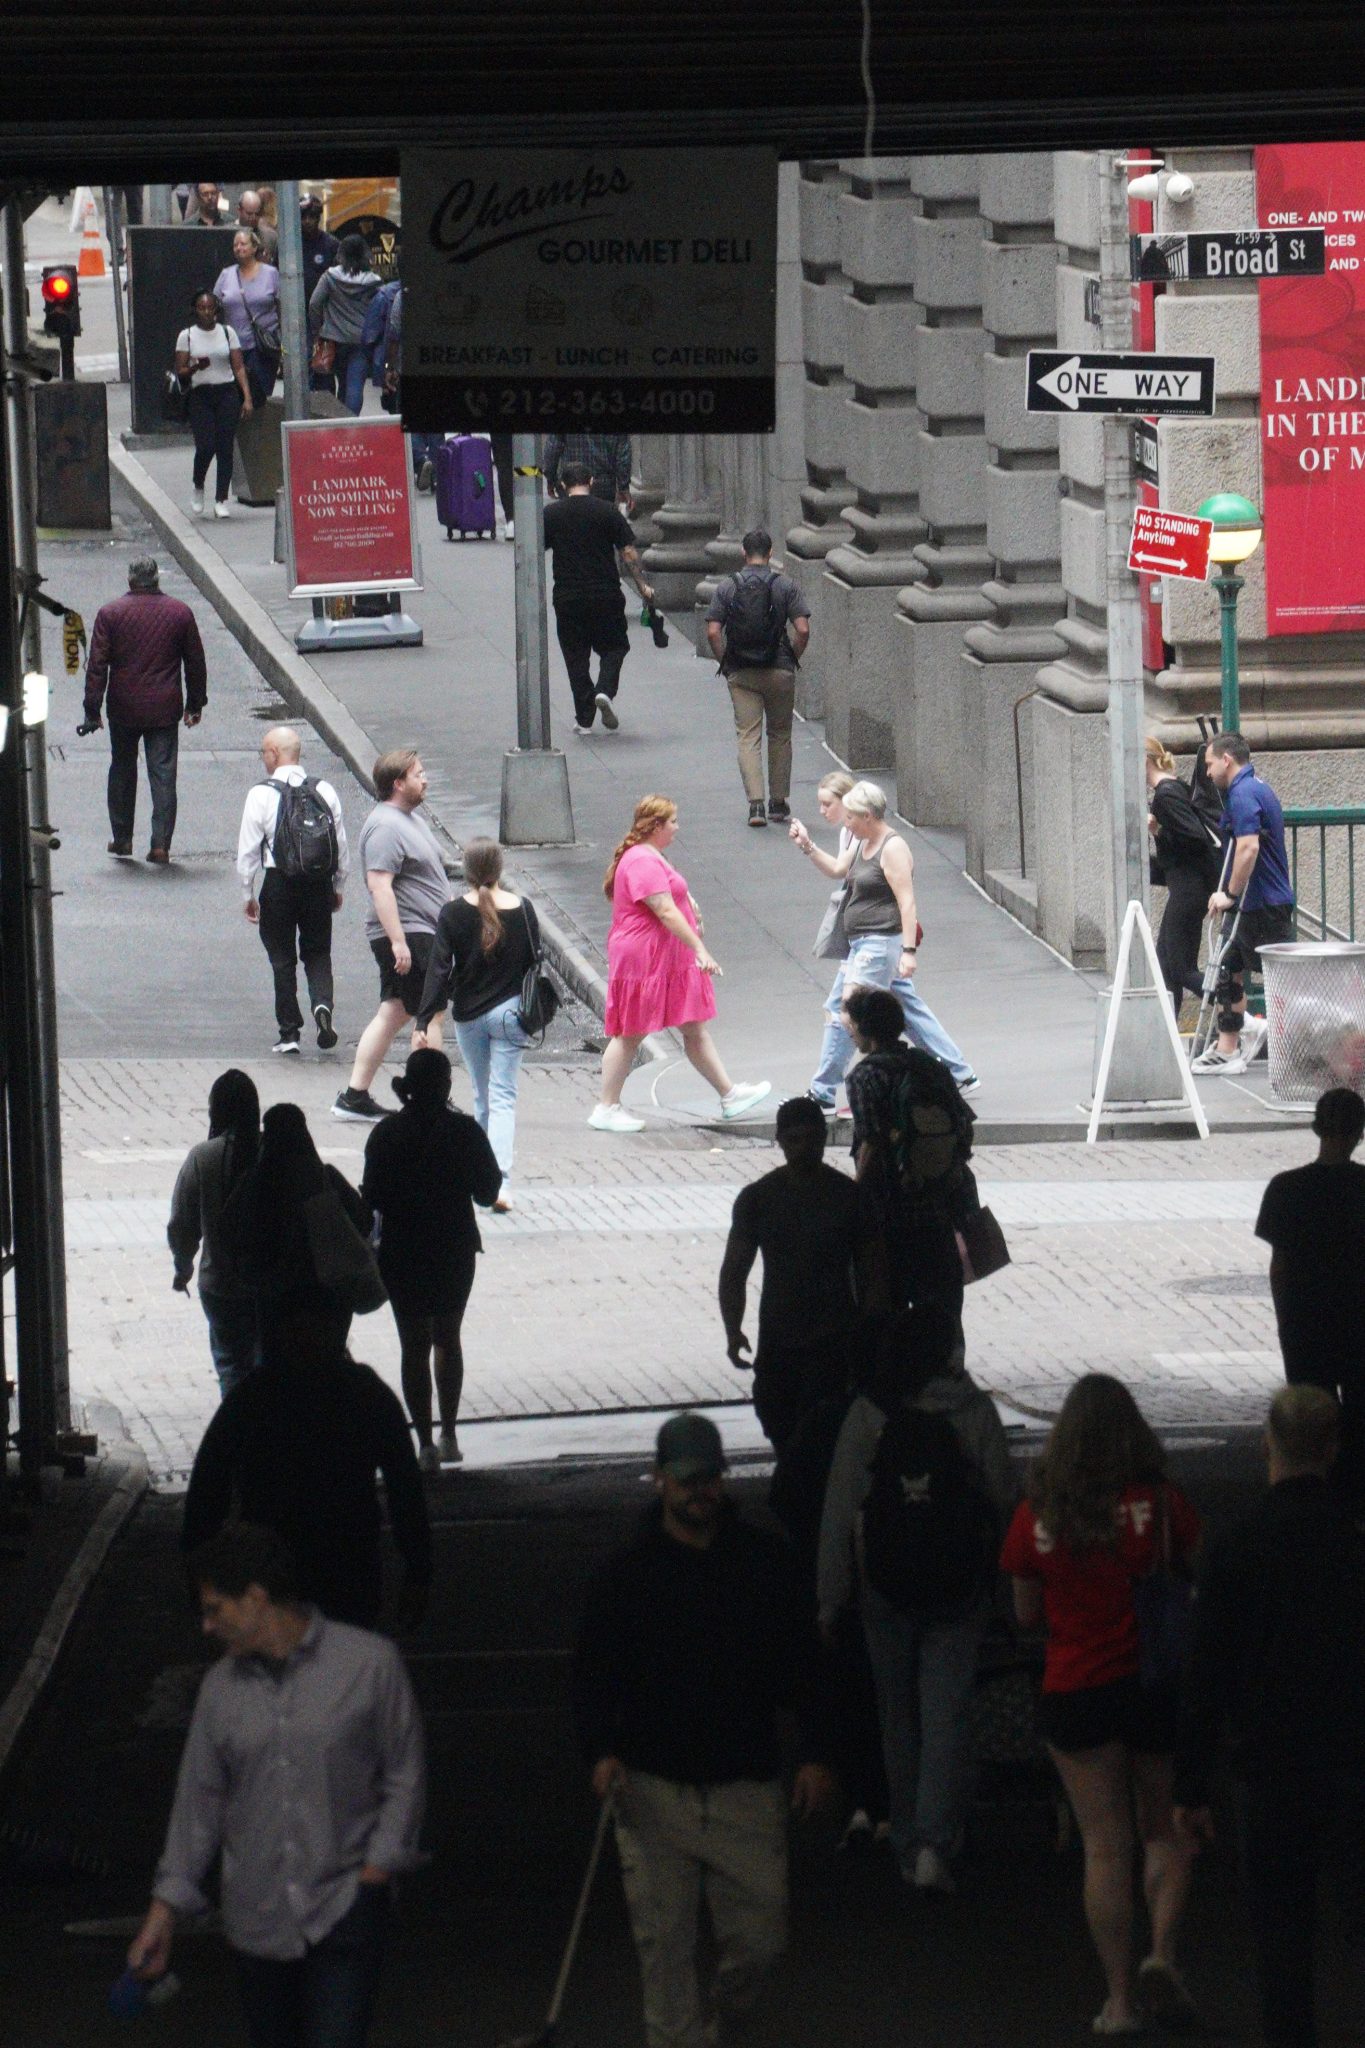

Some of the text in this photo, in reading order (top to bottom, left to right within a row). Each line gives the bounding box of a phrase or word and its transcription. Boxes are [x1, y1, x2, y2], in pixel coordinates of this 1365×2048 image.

[430, 165, 634, 252] Champs
[1267, 210, 1365, 225] ONE- AND TW
[1235, 231, 1260, 245] 21-59
[537, 239, 750, 264] GOURMET DELI
[1206, 238, 1306, 276] Broad St
[1329, 257, 1360, 271] AND
[417, 346, 532, 365] BREAKFAST
[556, 347, 629, 365] LUNCH
[652, 347, 758, 366] CATERING
[1057, 371, 1190, 397] ONE WAY
[1275, 376, 1365, 403] LAND
[500, 388, 715, 417] 212-363-4000
[1267, 411, 1365, 438] IN THE
[1299, 446, 1339, 472] OF
[313, 475, 387, 491] LANDMARK
[299, 488, 404, 505] CONDOMINIUMS
[308, 503, 395, 519] NOW SELLING
[1137, 528, 1175, 546] Anytime
[1139, 513, 1199, 537] NO STANDING
